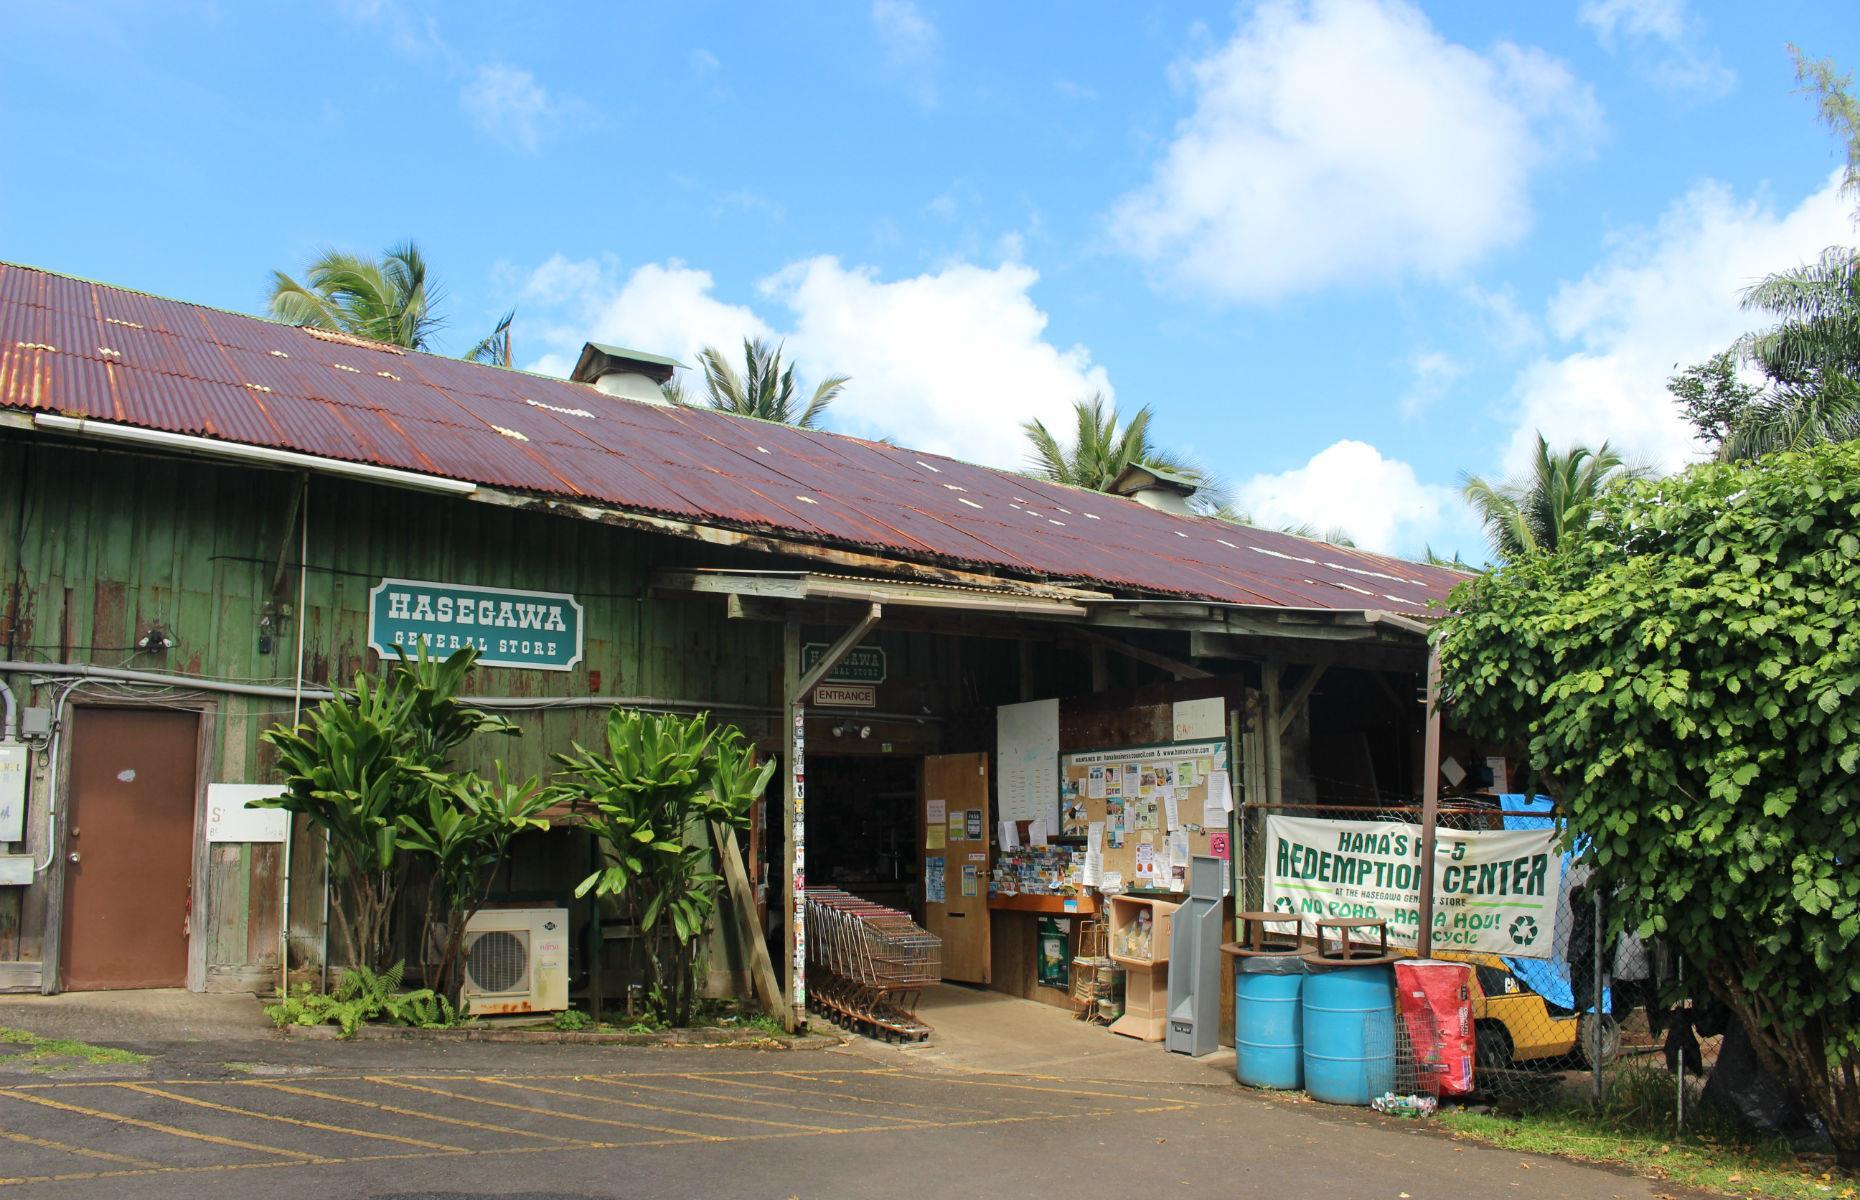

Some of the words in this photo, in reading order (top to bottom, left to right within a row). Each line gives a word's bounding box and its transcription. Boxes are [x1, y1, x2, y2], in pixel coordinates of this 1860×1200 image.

[388, 592, 566, 632] HASEGAWA
[395, 631, 487, 652] GENERAL
[499, 639, 557, 656] STORE
[819, 690, 871, 701] ENTRANCE
[1337, 831, 1408, 856] HANA'S
[1442, 853, 1547, 896] CENTER
[1335, 888, 1343, 896] AT
[1346, 889, 1359, 898] THE
[1361, 890, 1402, 901] HASEGAWA
[1440, 897, 1467, 907] STORE
[1300, 898, 1323, 915] NO
[1454, 912, 1502, 930] HOU!
